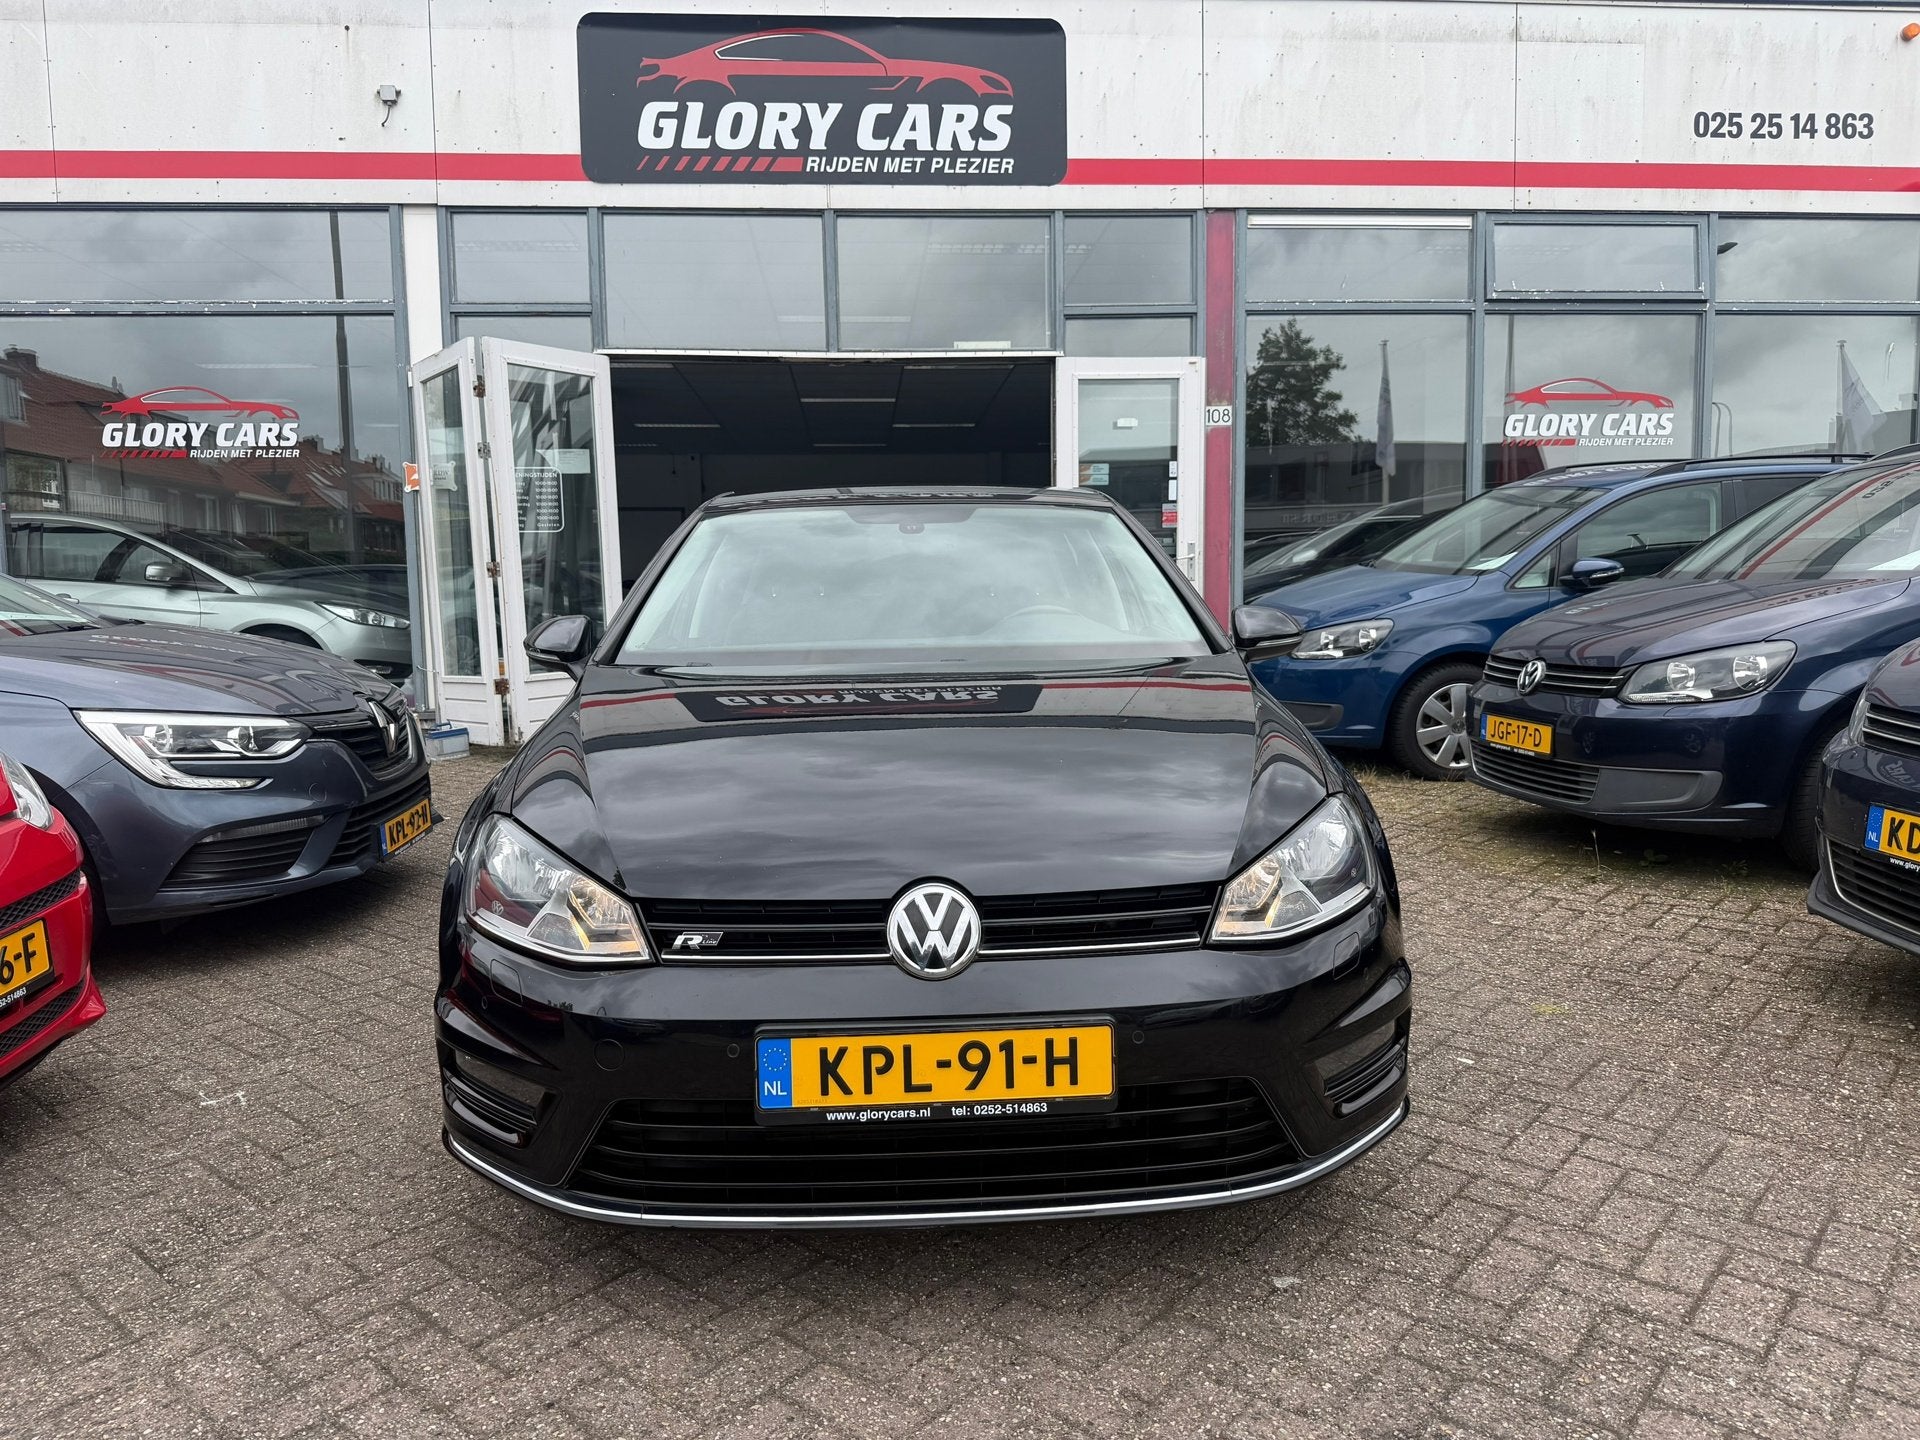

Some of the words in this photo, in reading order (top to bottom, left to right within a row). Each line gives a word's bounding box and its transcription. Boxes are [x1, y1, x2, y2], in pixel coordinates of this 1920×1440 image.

[637, 101, 844, 150] GLORY
[856, 103, 1014, 152] CARS
[1693, 111, 1743, 139] 025
[1750, 112, 1783, 140] 25
[1789, 112, 1818, 140] 14
[1825, 112, 1875, 140] 863
[805, 156, 879, 173] RIJDEN
[883, 157, 925, 173] MET
[930, 157, 1015, 174] PLEZIER
[1206, 408, 1231, 424] 108
[1503, 413, 1598, 437] GLORY
[1602, 413, 1675, 436] CARS
[101, 422, 209, 448] GLORY
[215, 422, 300, 448] CARS
[1578, 438, 1612, 447] RIJDEN
[1613, 438, 1633, 446] MET
[1633, 437, 1674, 446] PLEZIER
[189, 449, 228, 458] RIJDEN
[230, 449, 253, 458] MET
[255, 449, 300, 458] PLEZIER
[1490, 719, 1543, 748] JGF-17-D
[1868, 831, 1879, 842] NL
[818, 1036, 1079, 1097] KPL-91-H
[764, 1080, 788, 1096] NL
[826, 1107, 931, 1122] www.glorycars.nl
[951, 1105, 971, 1117] tel:
[973, 1102, 1048, 1116] 0252-514863
